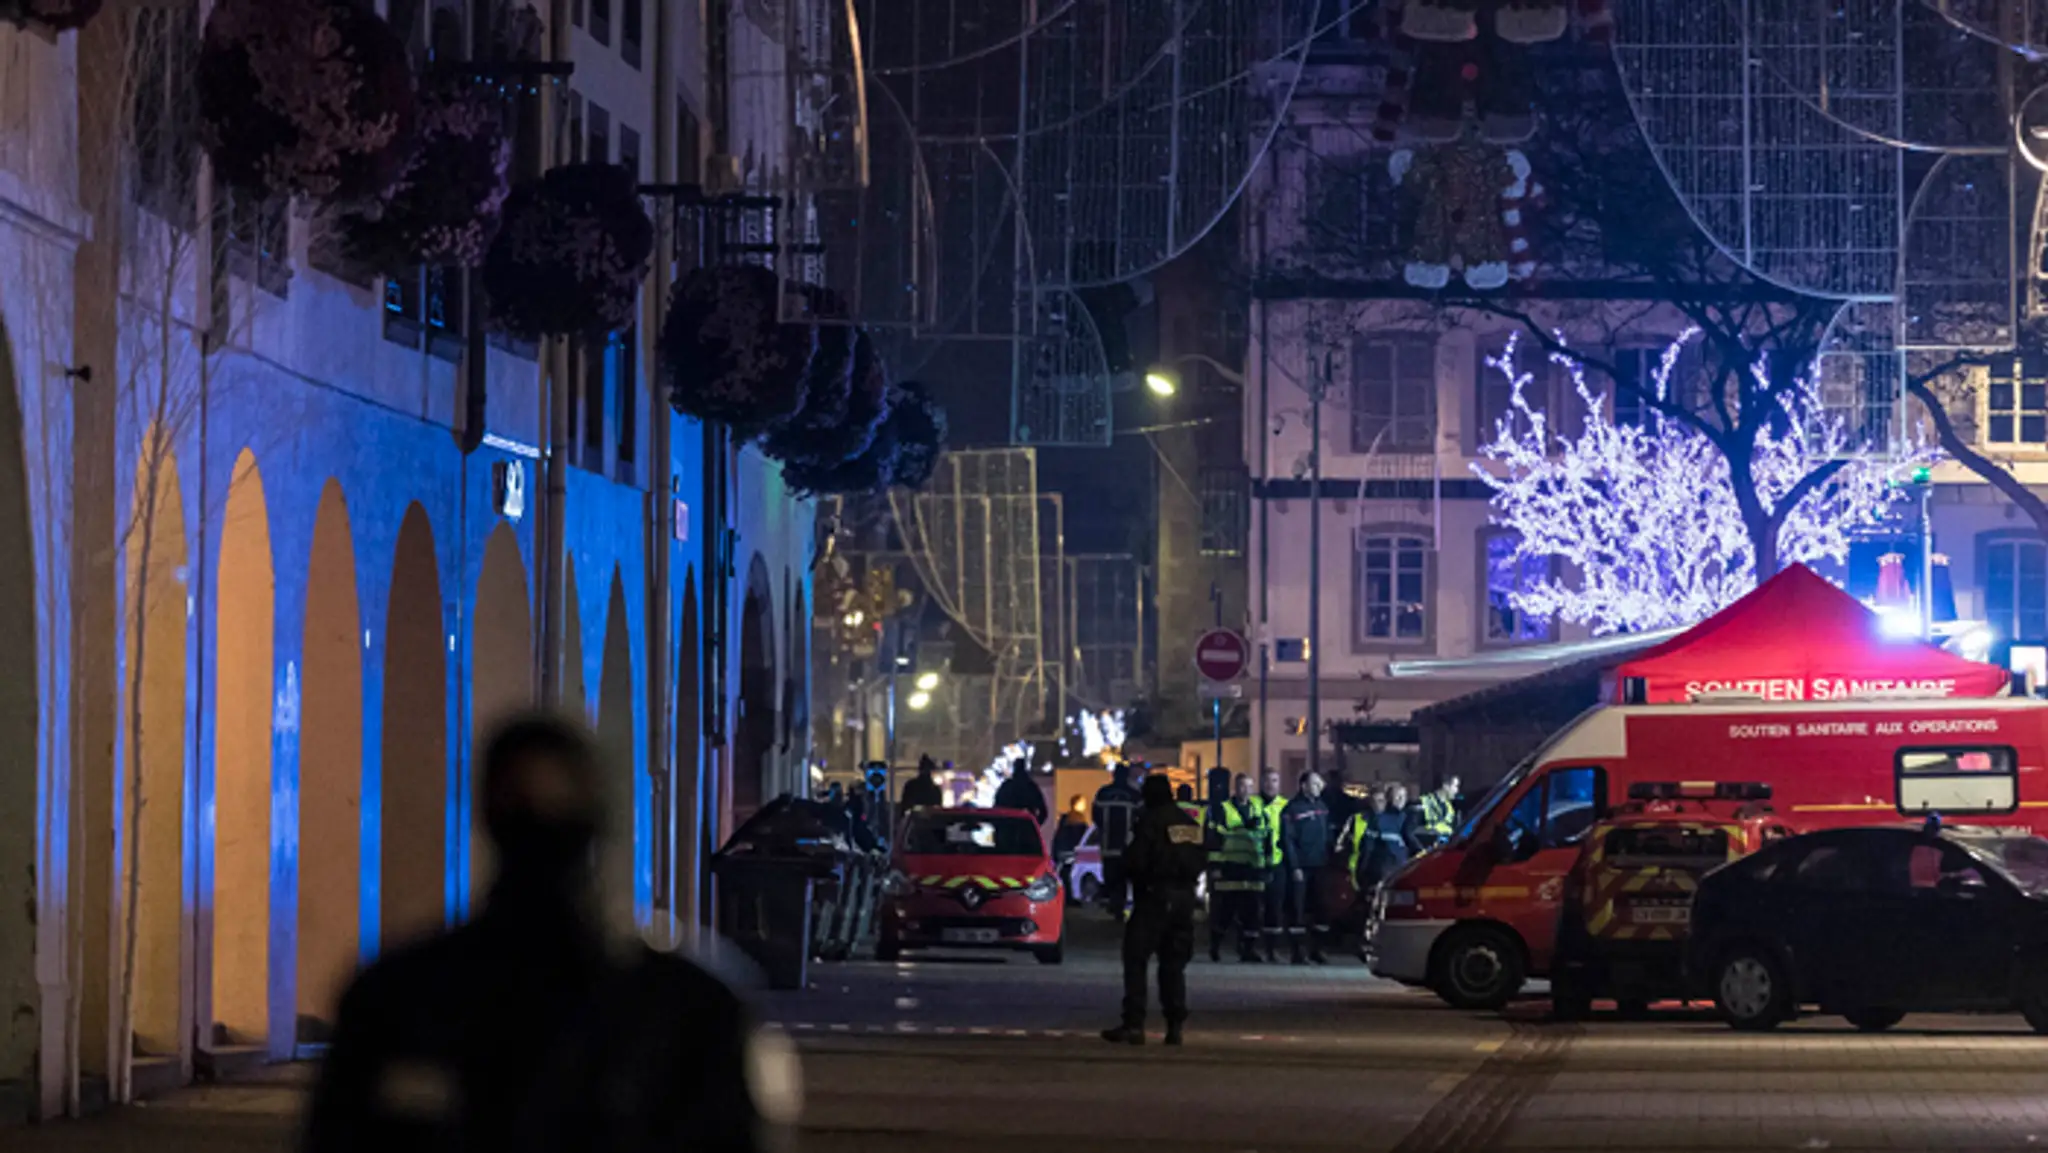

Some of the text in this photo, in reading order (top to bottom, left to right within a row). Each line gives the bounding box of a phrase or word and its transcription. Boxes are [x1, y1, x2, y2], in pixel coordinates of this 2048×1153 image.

[1729, 719, 1999, 738] SOUTIEN SANITAIRE AUX OPERATIONS
